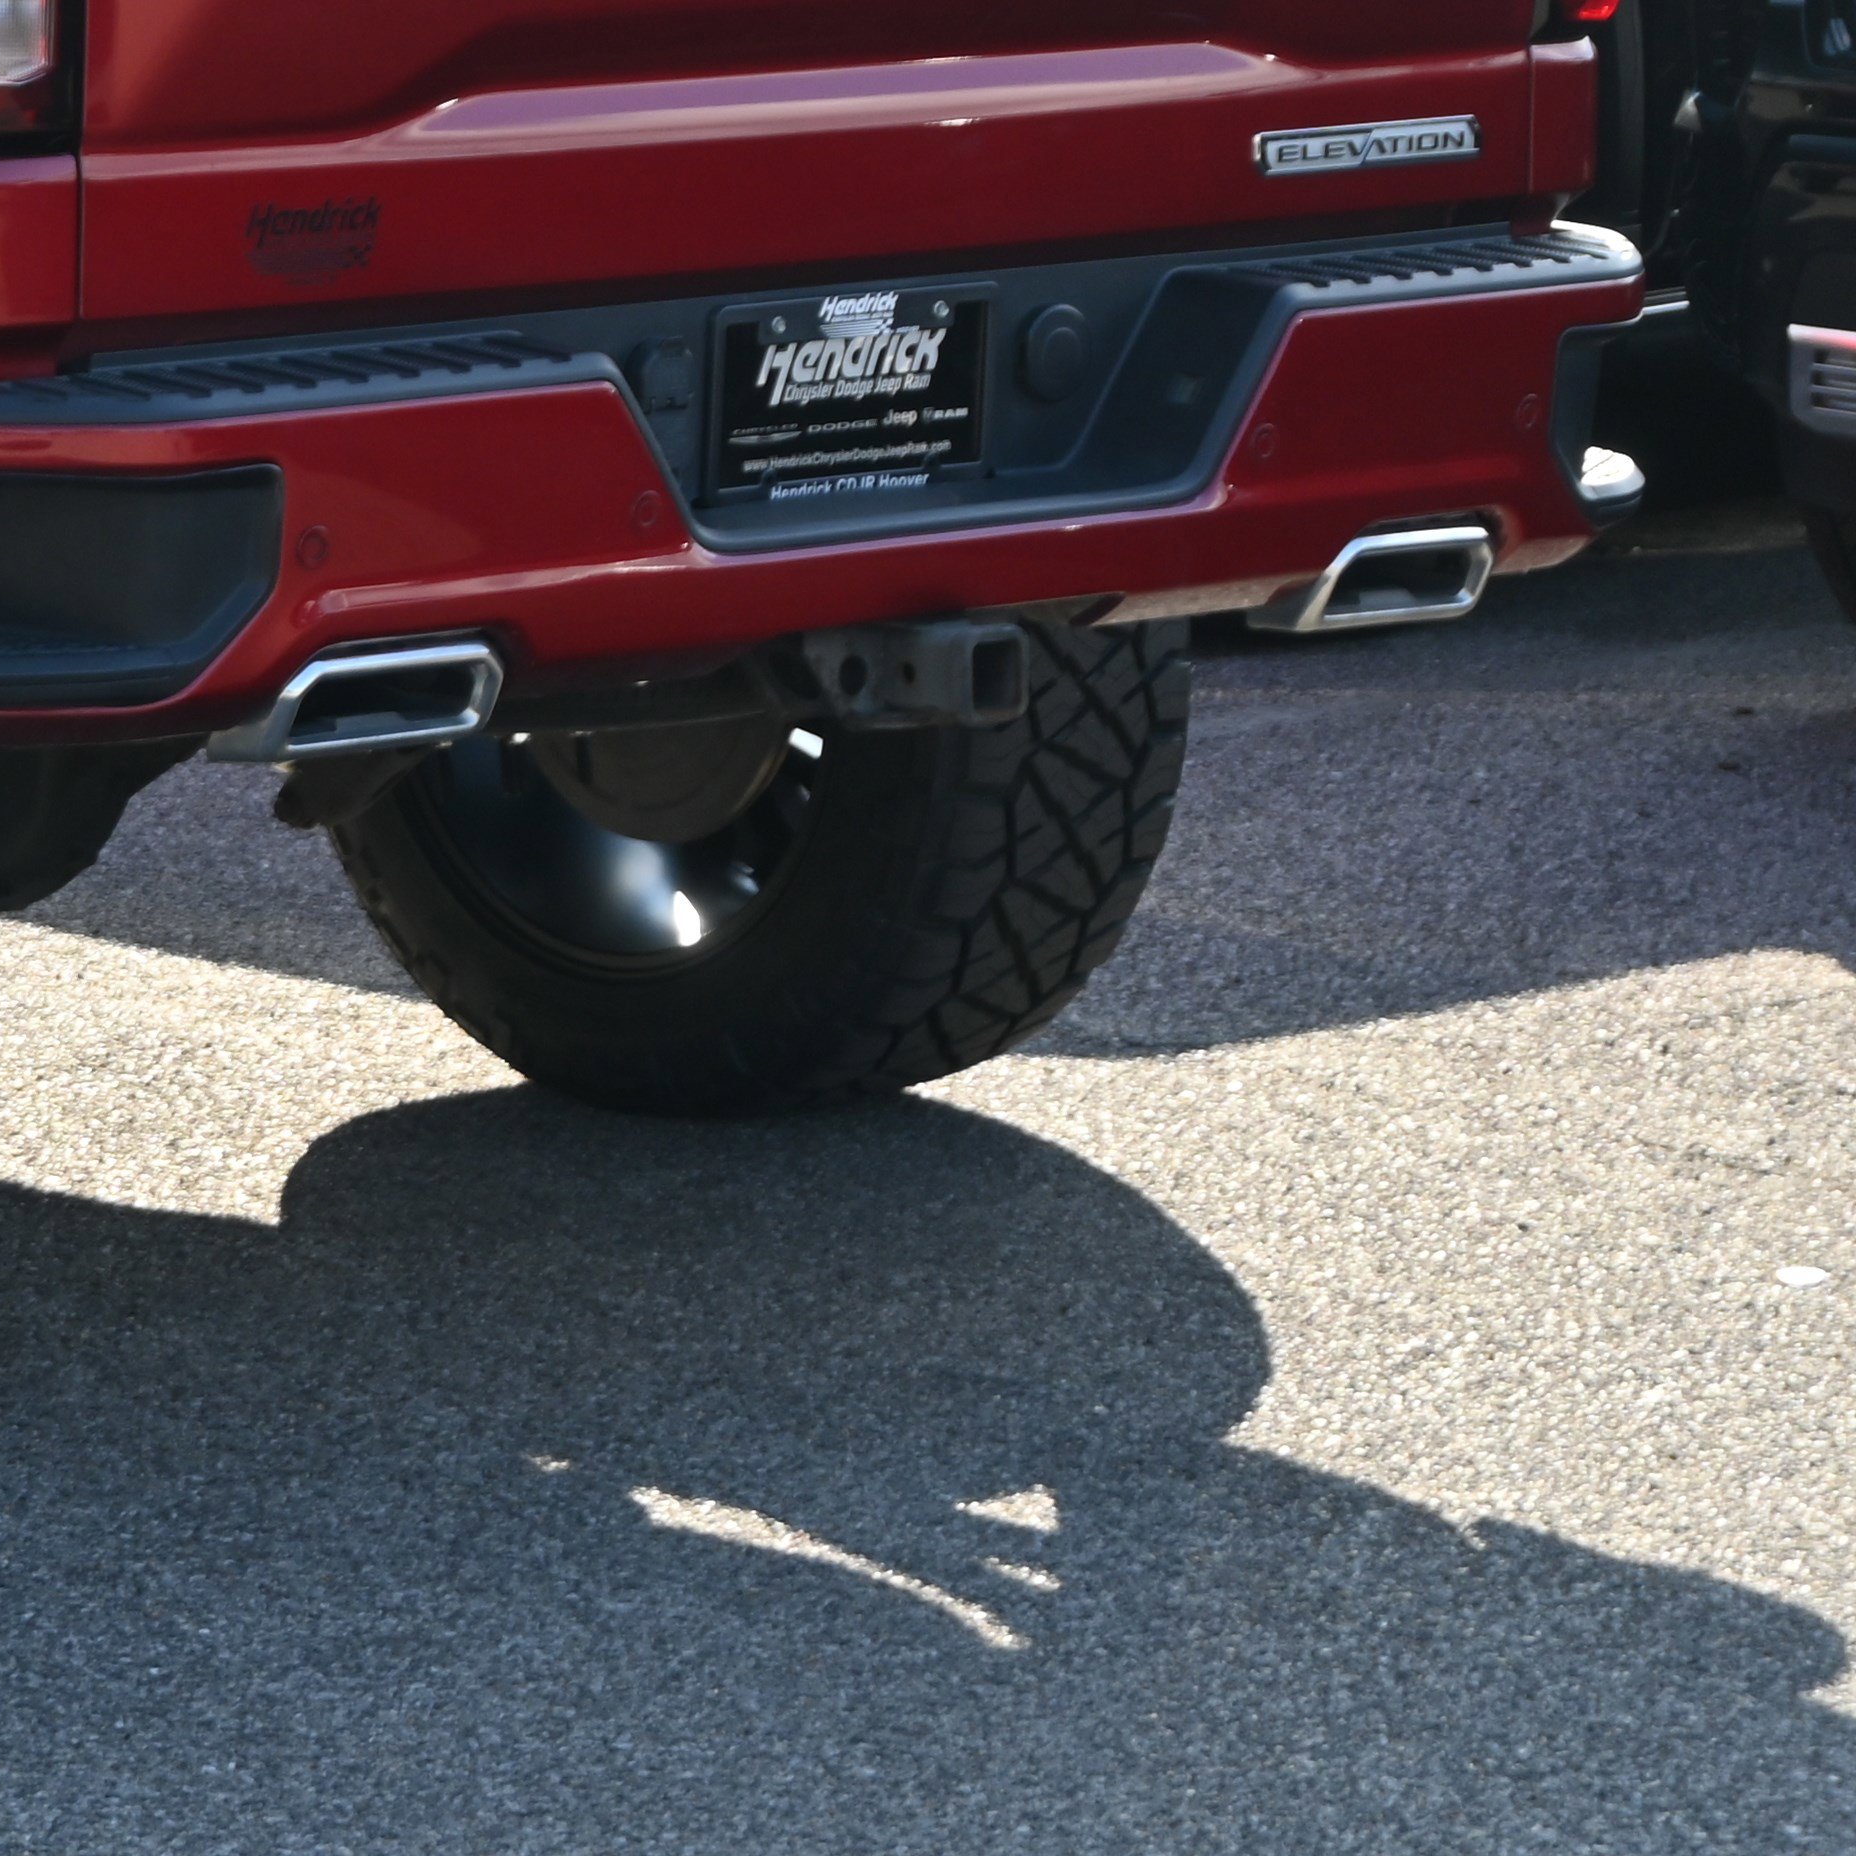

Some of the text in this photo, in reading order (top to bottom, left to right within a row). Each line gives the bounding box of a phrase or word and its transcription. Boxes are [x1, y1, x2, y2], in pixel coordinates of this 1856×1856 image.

[1277, 131, 1465, 162] ELEVATION
[245, 194, 384, 250] Hendrick
[818, 291, 899, 322] Hendrick
[755, 328, 947, 407] Hendrick
[783, 373, 932, 406] Chrysler Dodge Jeep Ram
[807, 418, 877, 433] DODGE
[883, 408, 918, 426] Jeep
[934, 407, 969, 419] RAM
[770, 480, 832, 501] Hendrick
[879, 472, 930, 489] Hoover
